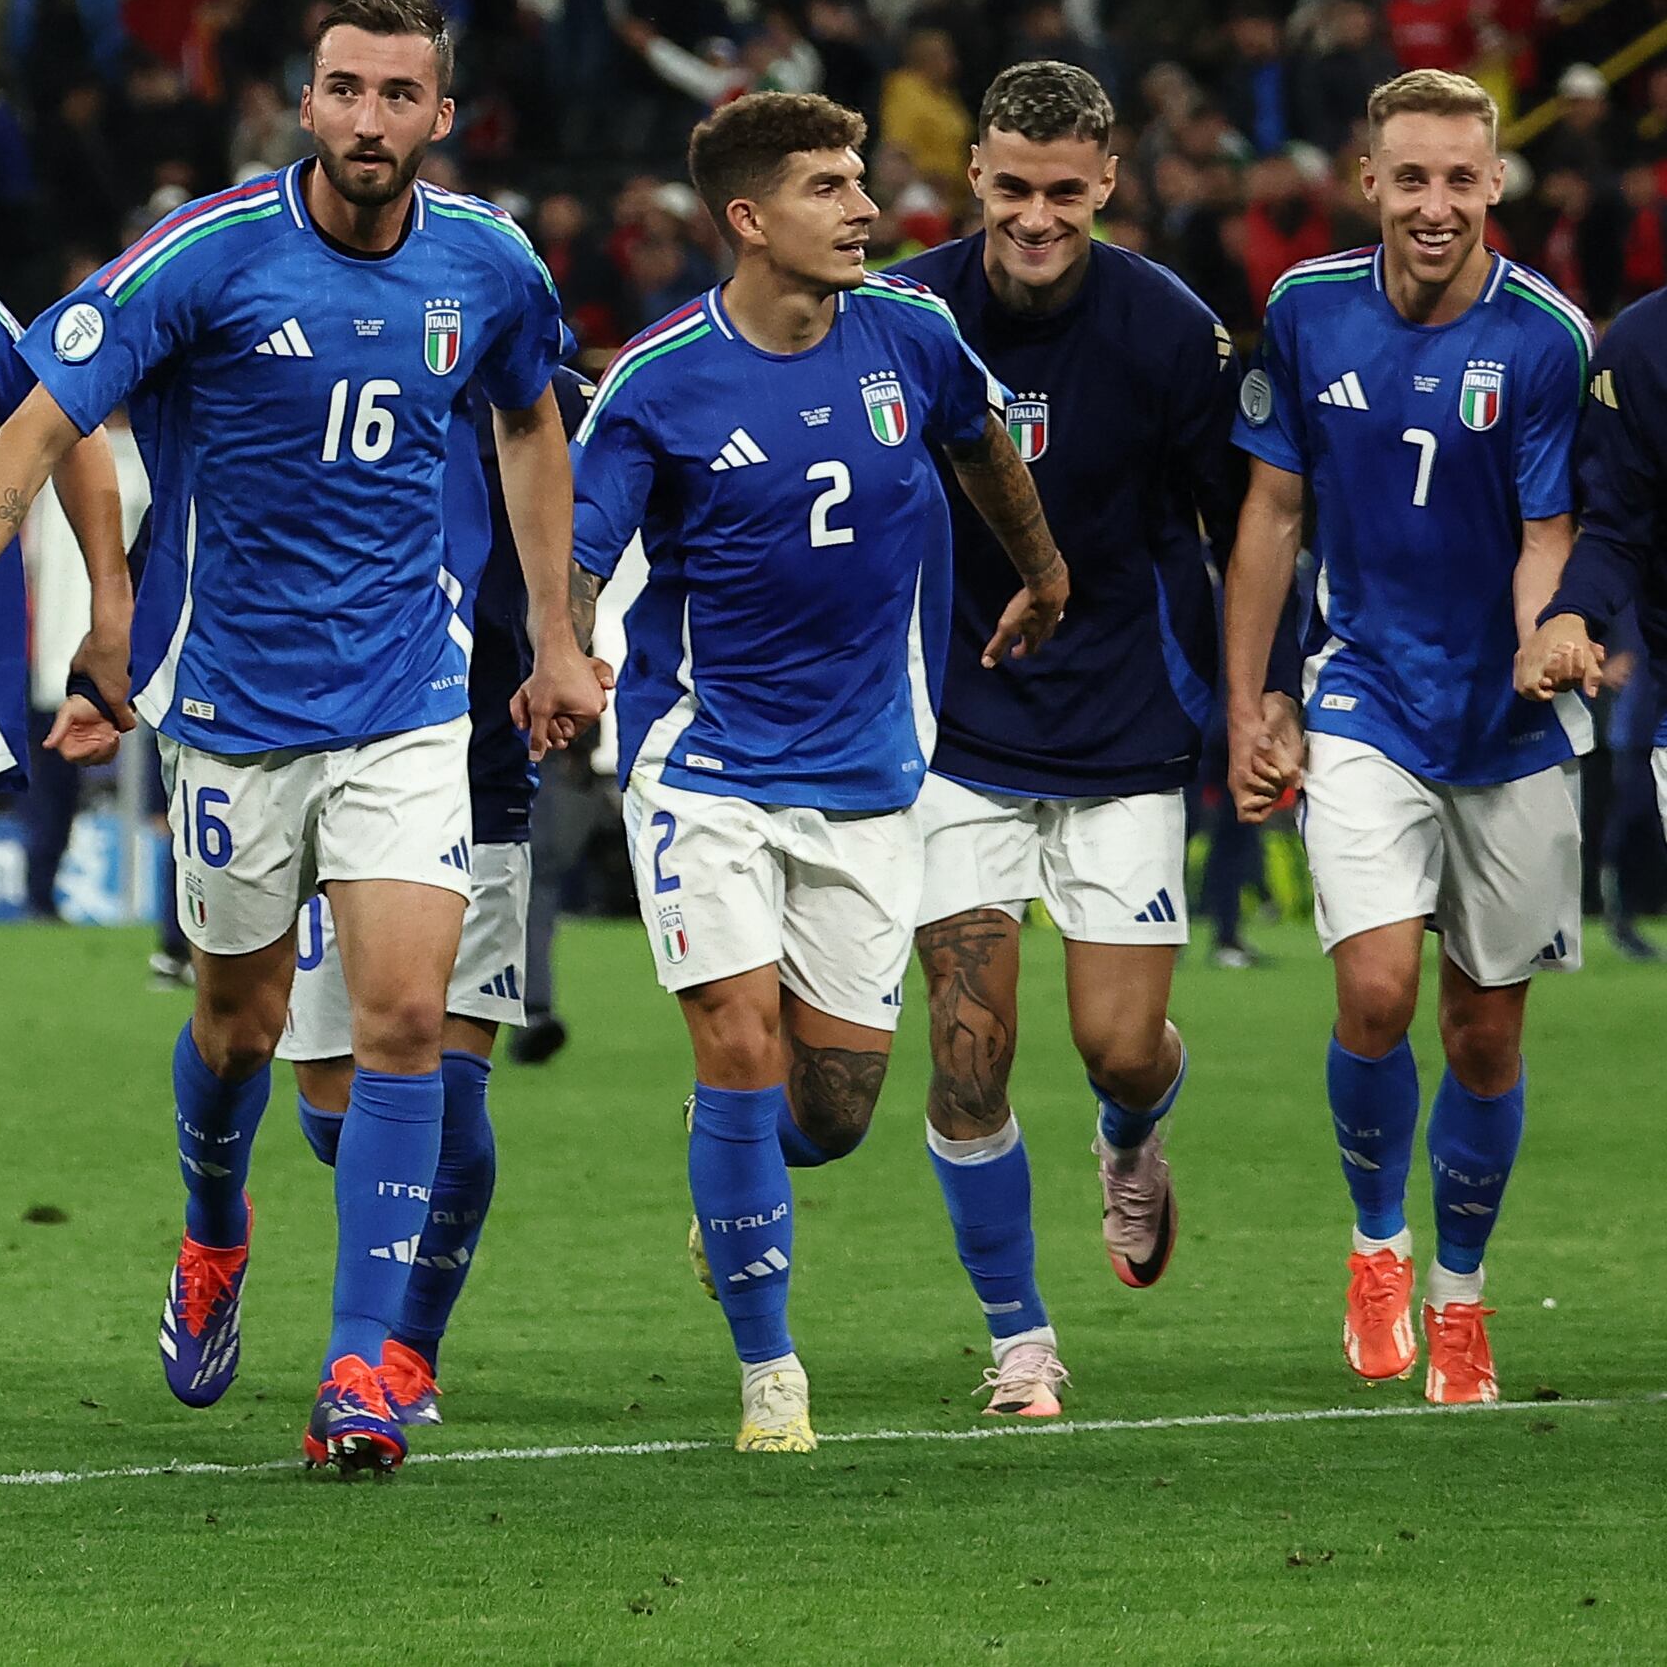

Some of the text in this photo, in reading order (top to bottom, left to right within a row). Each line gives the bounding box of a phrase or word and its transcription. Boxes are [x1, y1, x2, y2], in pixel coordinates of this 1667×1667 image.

[429, 315, 456, 329] ITALIA
[867, 386, 898, 404] ITALIA
[1466, 375, 1497, 388] ITALIA
[321, 378, 401, 462] 16
[1009, 407, 1043, 420] ITALIA
[1401, 427, 1438, 508] 7
[805, 460, 854, 548] 2
[182, 779, 233, 868] 16
[651, 811, 681, 894] 2
[710, 1202, 788, 1233] ITALIA
